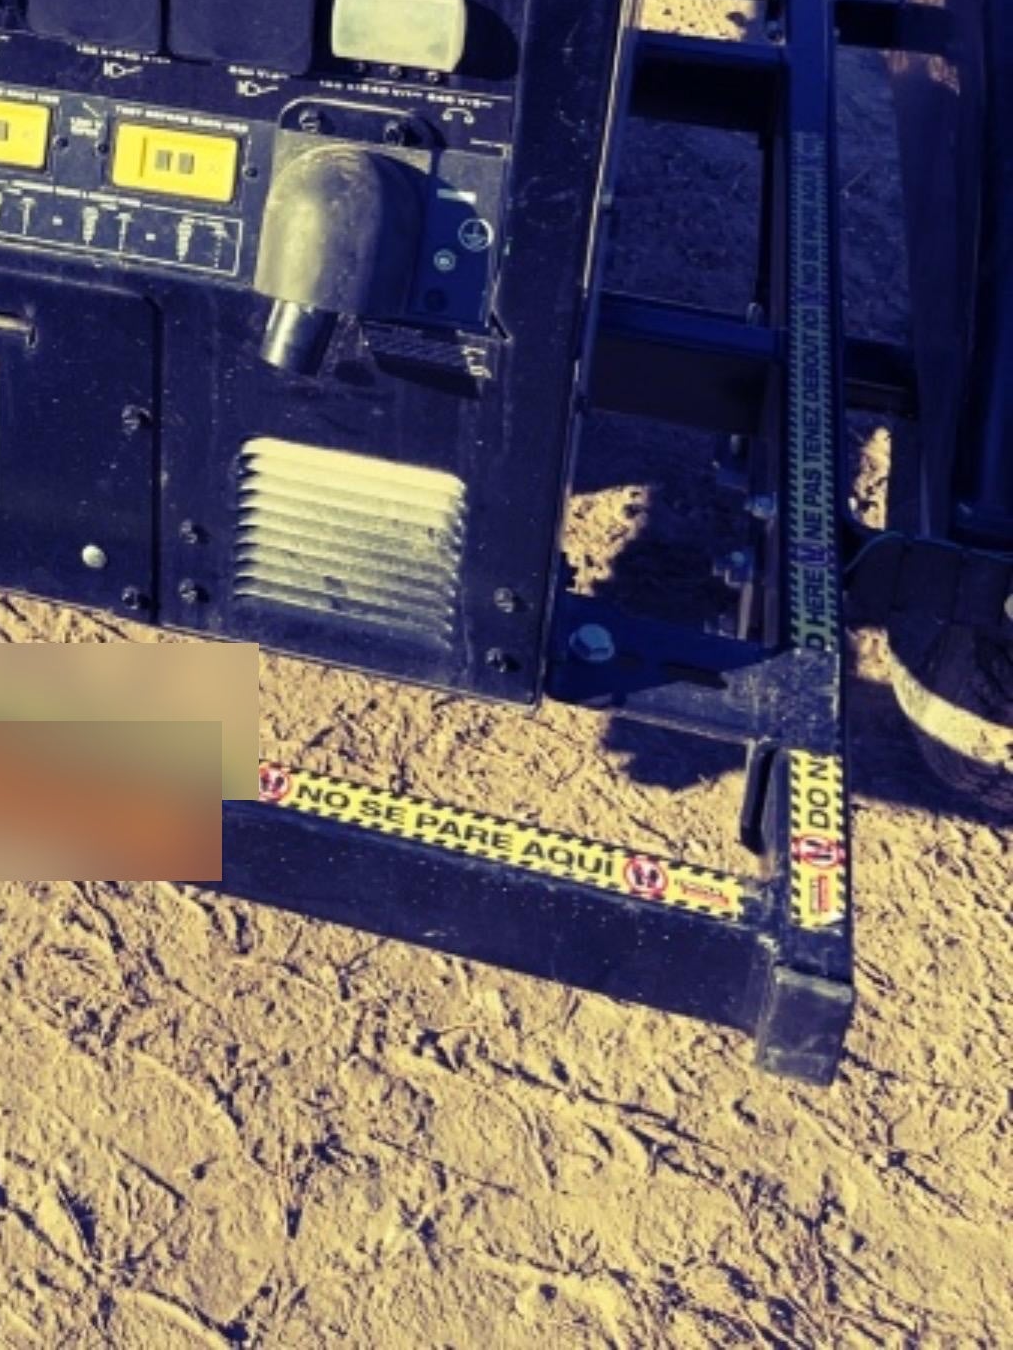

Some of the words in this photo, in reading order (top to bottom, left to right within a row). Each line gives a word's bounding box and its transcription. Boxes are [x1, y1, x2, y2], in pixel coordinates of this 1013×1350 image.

[803, 405, 822, 462] TENEZ
[803, 468, 822, 507] PAS
[803, 508, 823, 540] NE
[295, 781, 350, 810] NO
[358, 798, 407, 825] SE
[415, 813, 514, 851] PARE
[807, 787, 830, 829] DO
